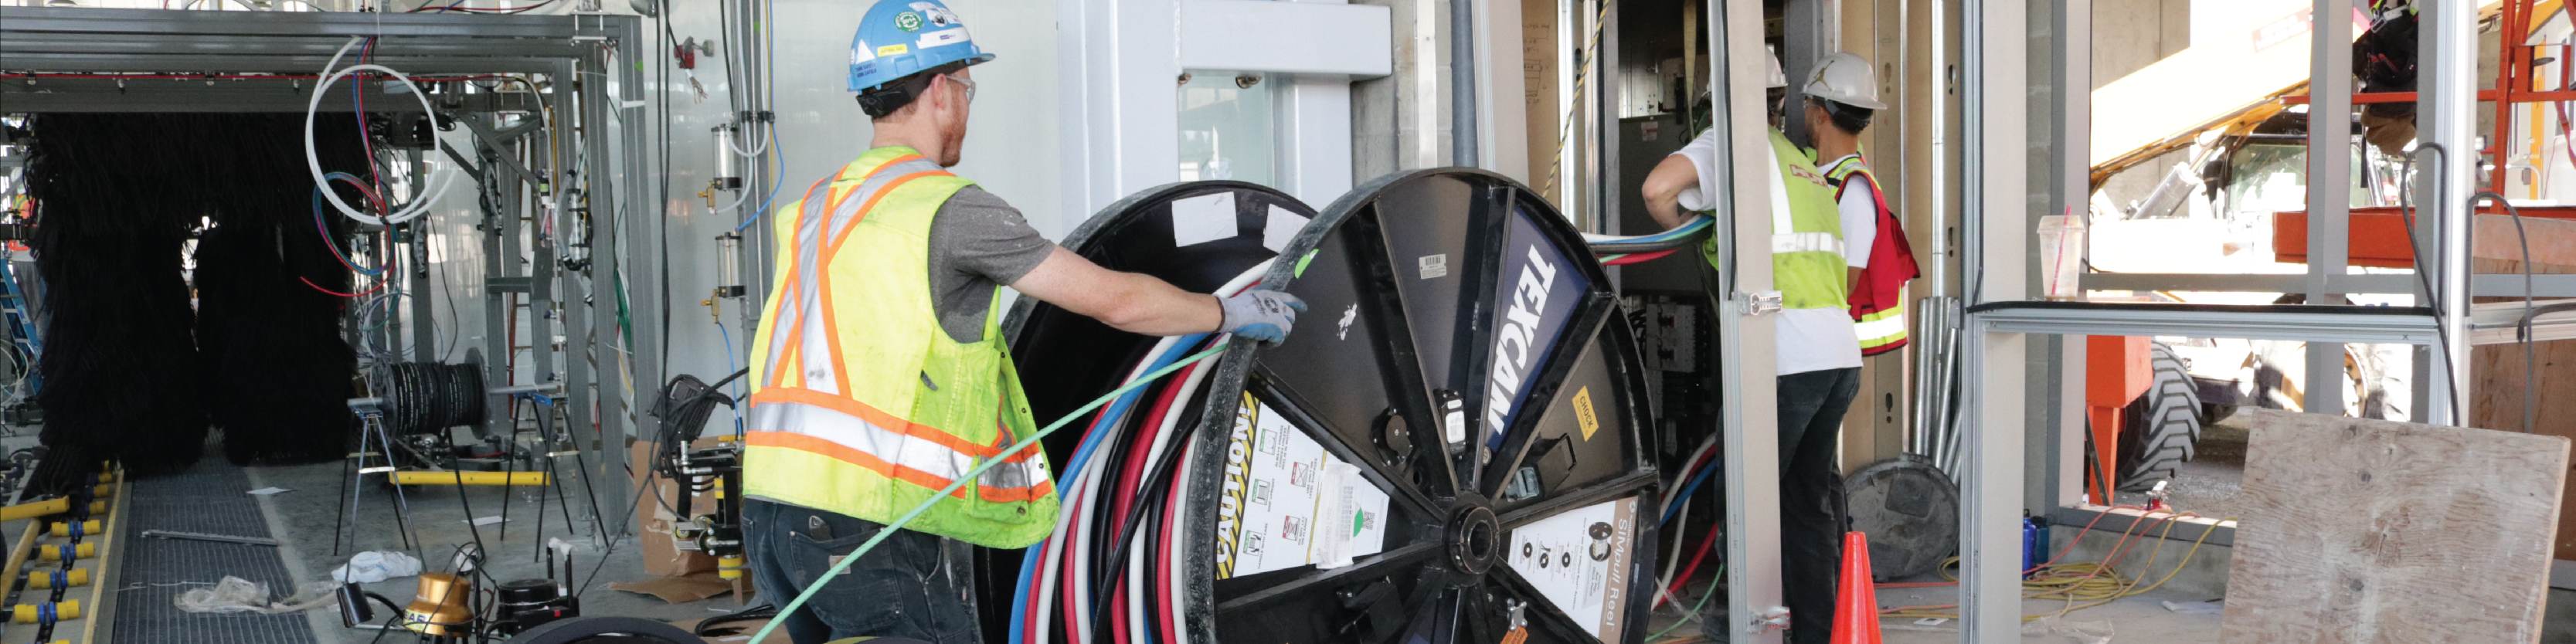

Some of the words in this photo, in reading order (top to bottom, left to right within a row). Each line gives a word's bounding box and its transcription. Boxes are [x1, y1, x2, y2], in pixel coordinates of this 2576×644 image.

[1488, 244, 1556, 436] TEXCAN
[1579, 396, 1593, 429] CHOCK
[1217, 407, 1252, 564] CAUTION!
[1613, 518, 1627, 584] SIMpull
[1606, 588, 1619, 626] Reel
